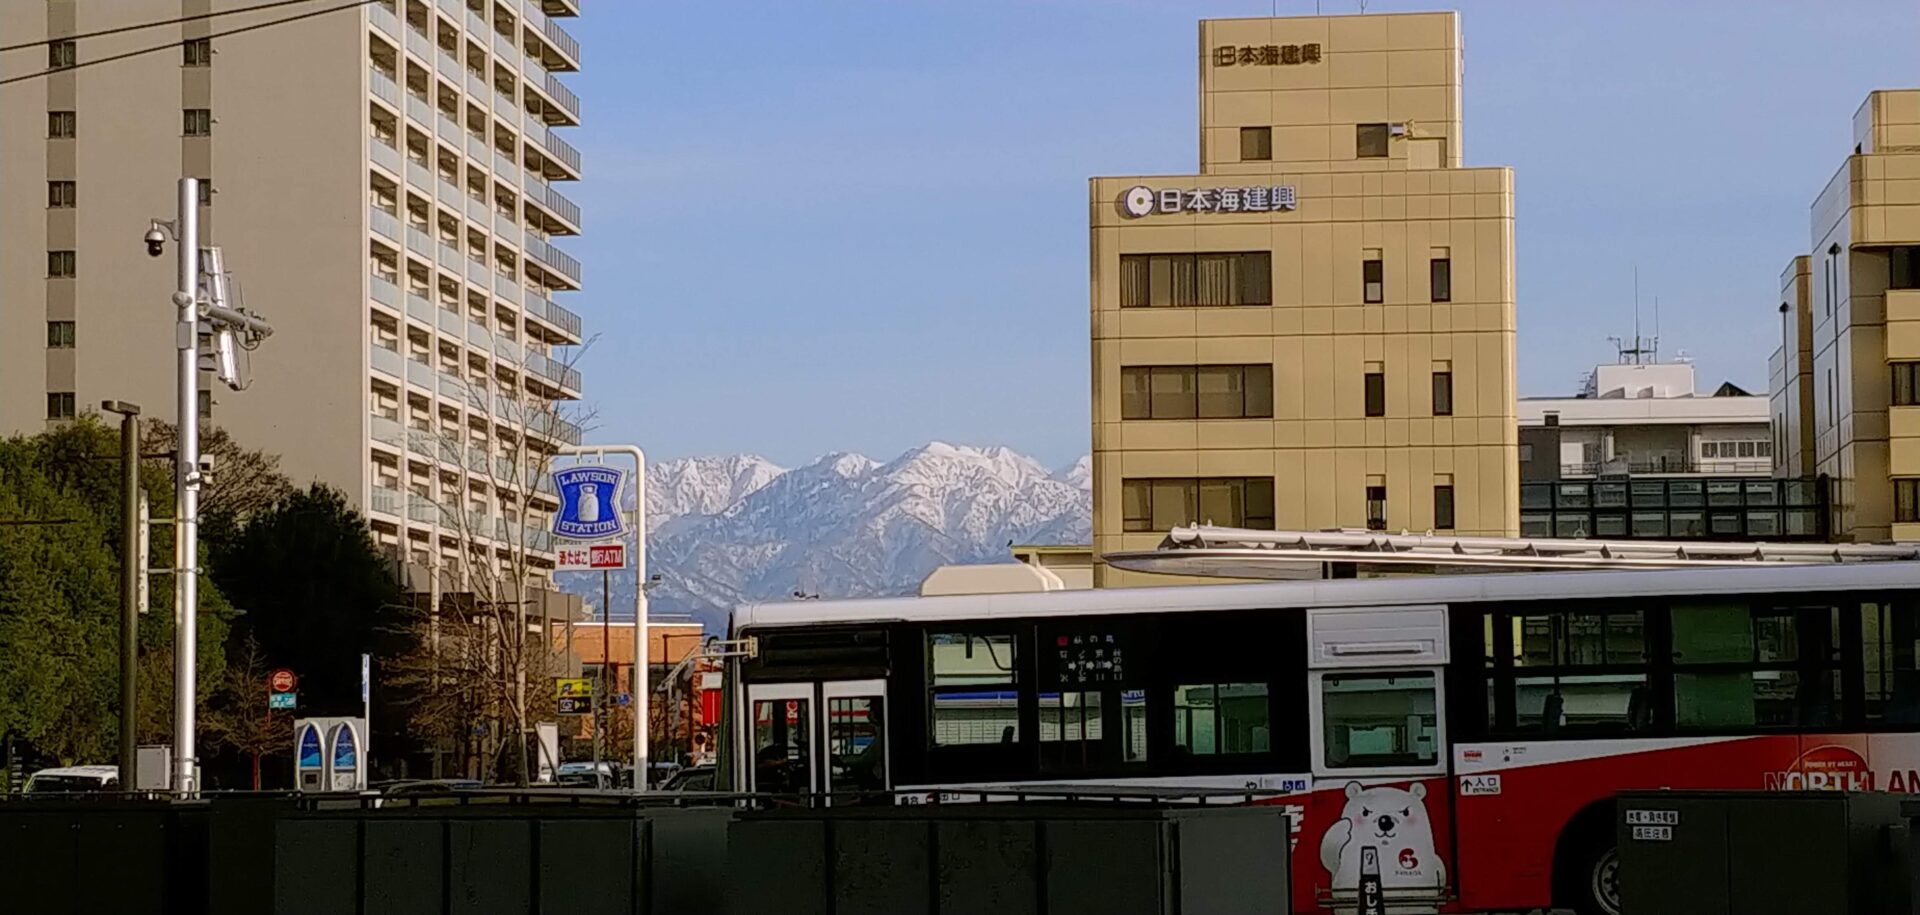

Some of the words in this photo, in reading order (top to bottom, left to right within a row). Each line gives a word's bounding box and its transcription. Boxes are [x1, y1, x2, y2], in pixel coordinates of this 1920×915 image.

[1214, 43, 1321, 67] 日本海建興
[1160, 185, 1297, 213] 日本海建興
[559, 471, 617, 486] LAWSON
[560, 519, 618, 534] STATION
[1475, 777, 1497, 787] 入口
